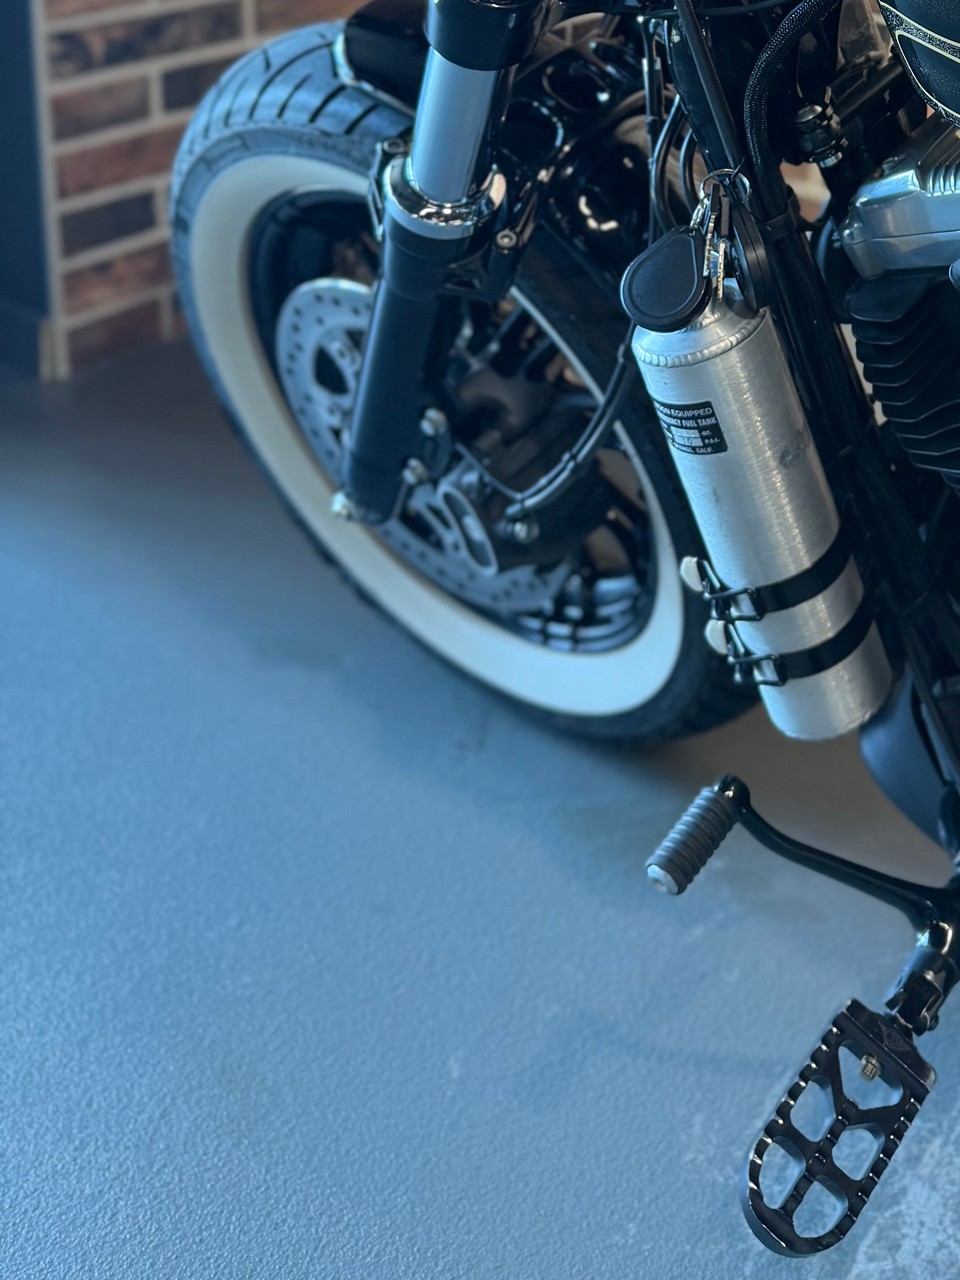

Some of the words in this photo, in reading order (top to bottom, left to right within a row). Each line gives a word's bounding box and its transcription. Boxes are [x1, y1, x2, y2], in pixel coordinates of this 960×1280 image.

[671, 407, 713, 418] EQUIPPED
[682, 419, 698, 428] FUEL
[698, 416, 718, 427] TANK
